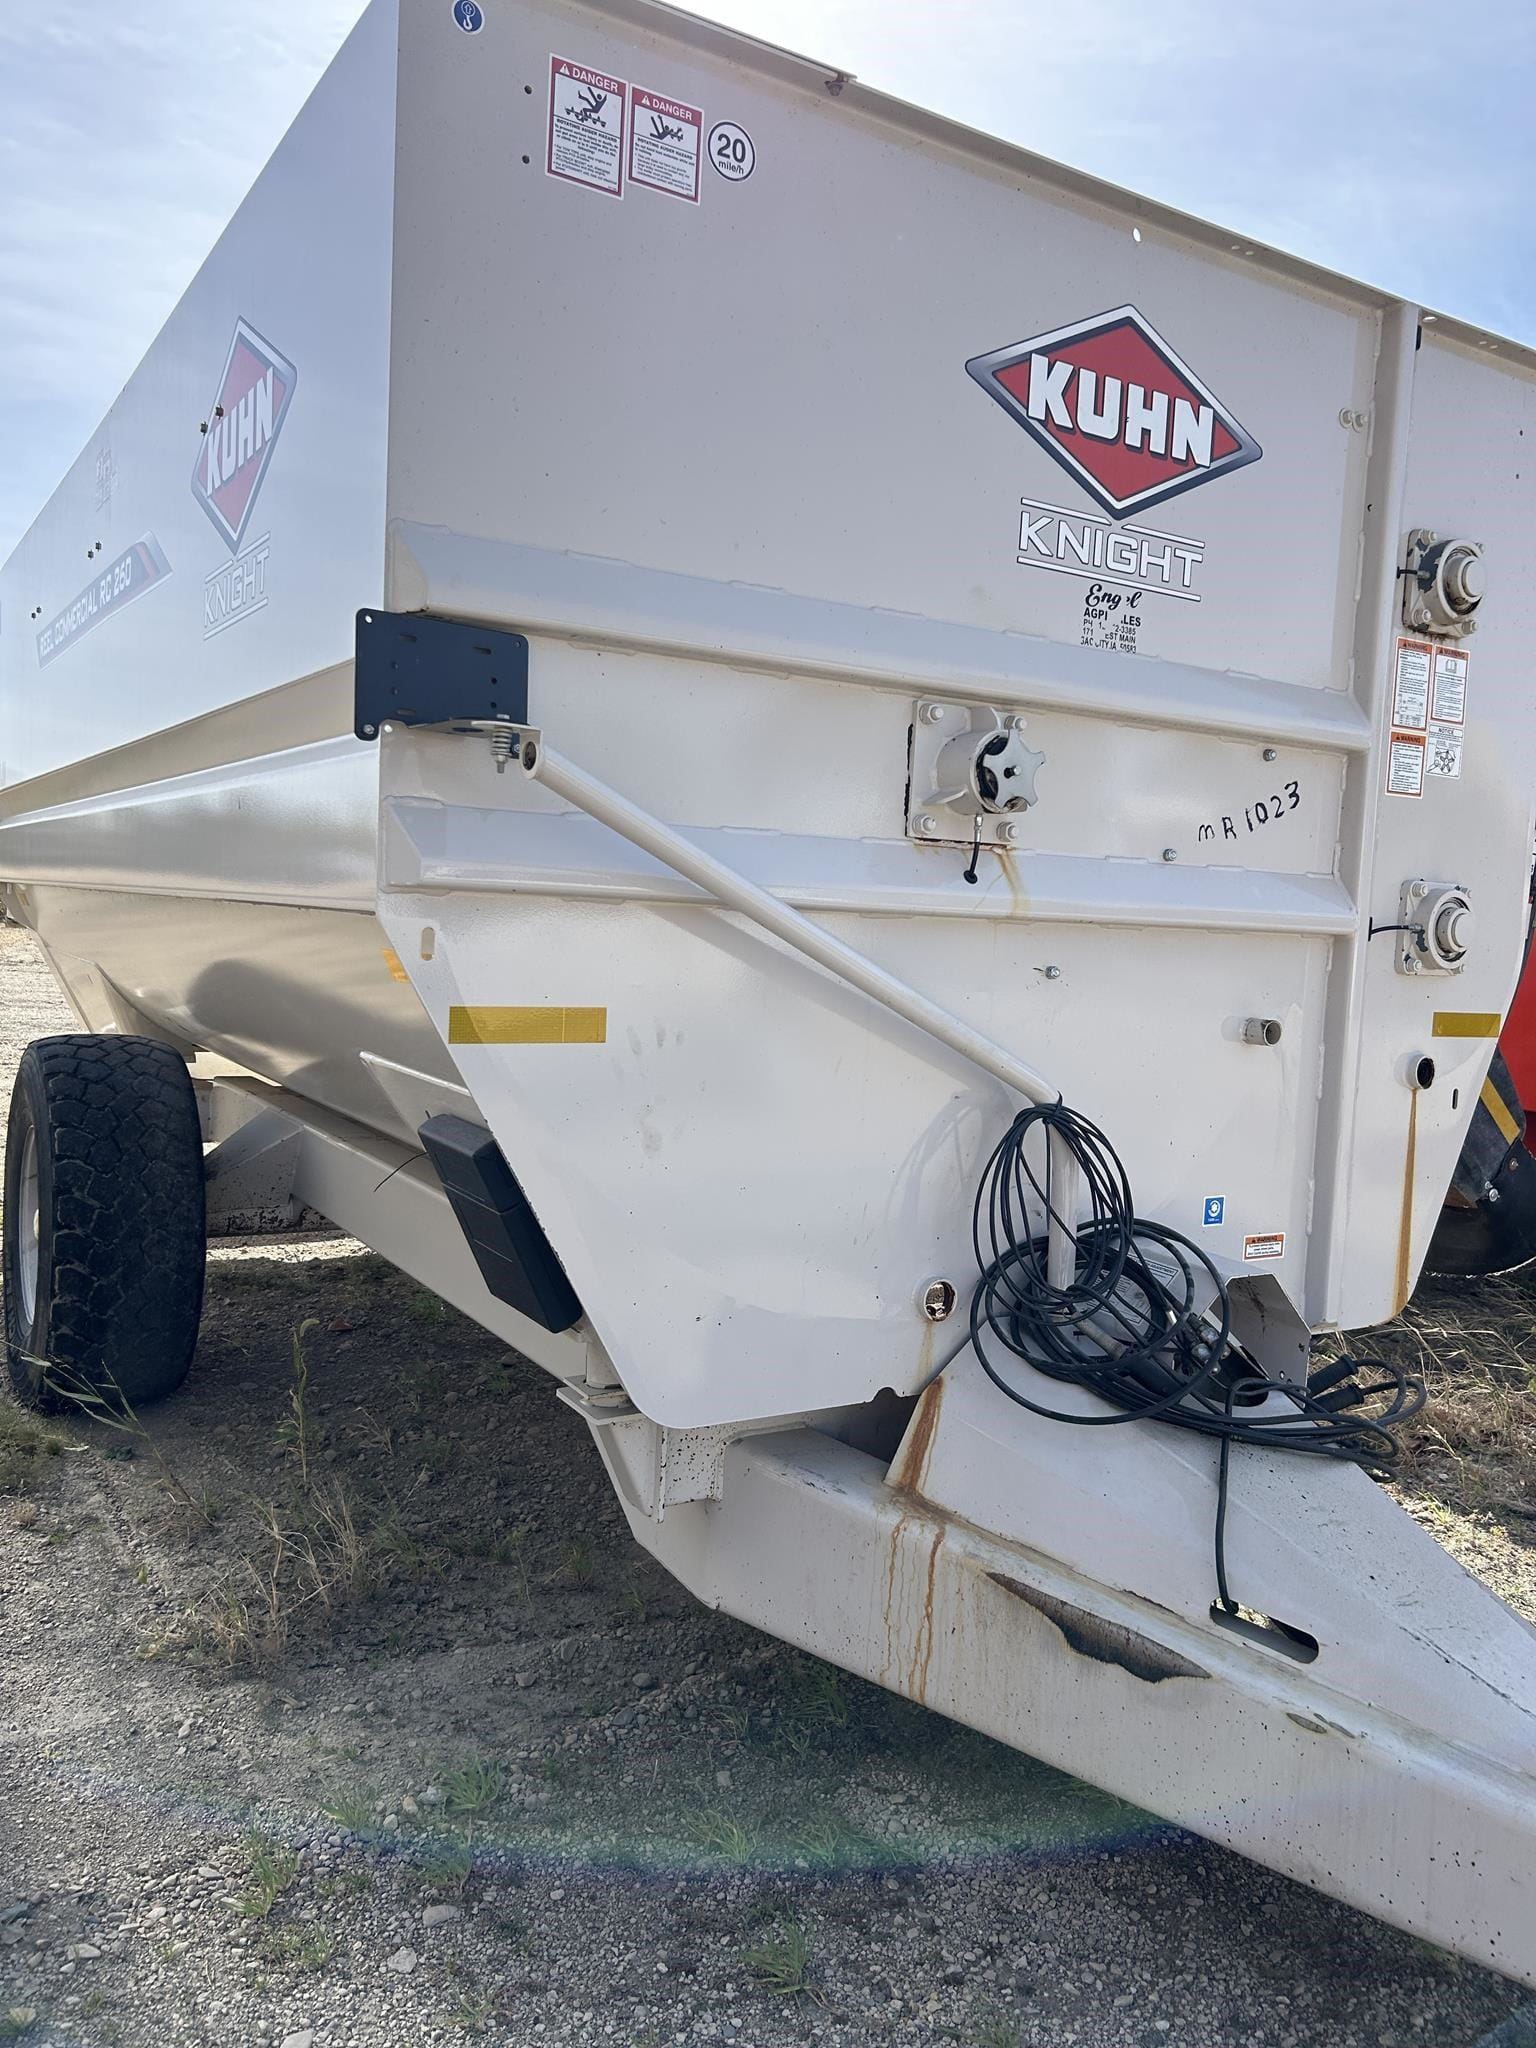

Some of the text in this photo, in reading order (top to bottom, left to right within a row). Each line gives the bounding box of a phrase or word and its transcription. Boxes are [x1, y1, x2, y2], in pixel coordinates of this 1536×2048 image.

[571, 66, 619, 93] DANGER
[652, 98, 692, 121] DANGER
[717, 133, 746, 164] 20
[718, 159, 744, 176] mile/h
[1027, 352, 1214, 469] KUHN
[206, 366, 274, 499] KUHN
[1019, 510, 1203, 588] KNIGHT
[100, 573, 112, 609] RC
[113, 556, 132, 597] 260
[204, 547, 270, 628] KNIGHT
[1401, 735, 1421, 743] WARNING
